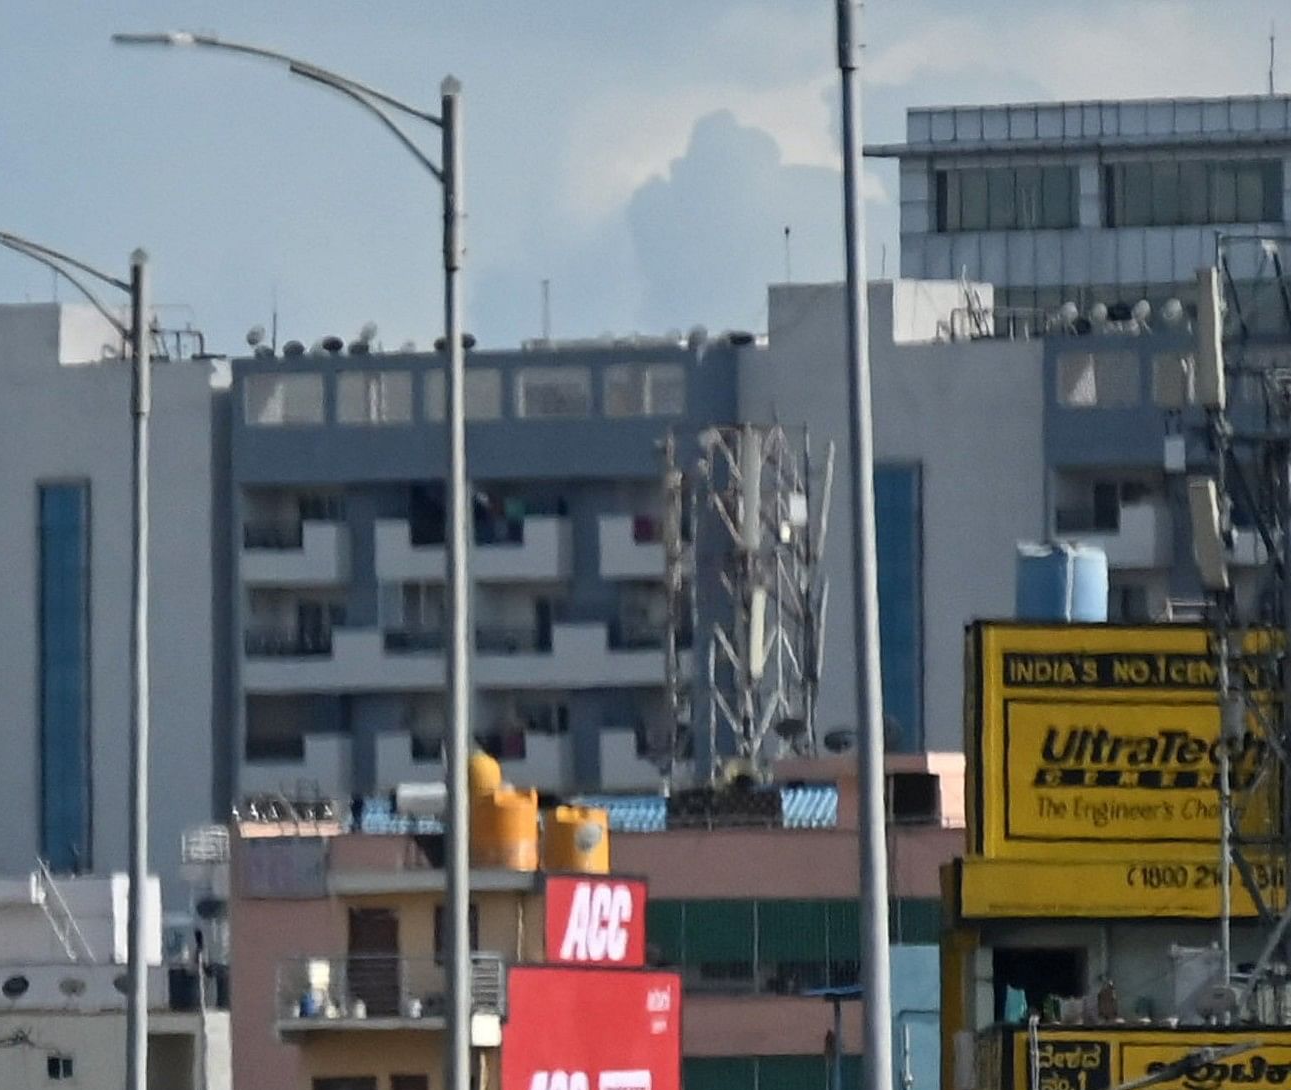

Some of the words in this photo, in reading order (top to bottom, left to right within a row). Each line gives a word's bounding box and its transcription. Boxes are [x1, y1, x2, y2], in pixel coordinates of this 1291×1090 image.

[1010, 658, 1098, 684] INDIA'S
[1038, 797, 1066, 819] The
[560, 881, 632, 961] ACC
